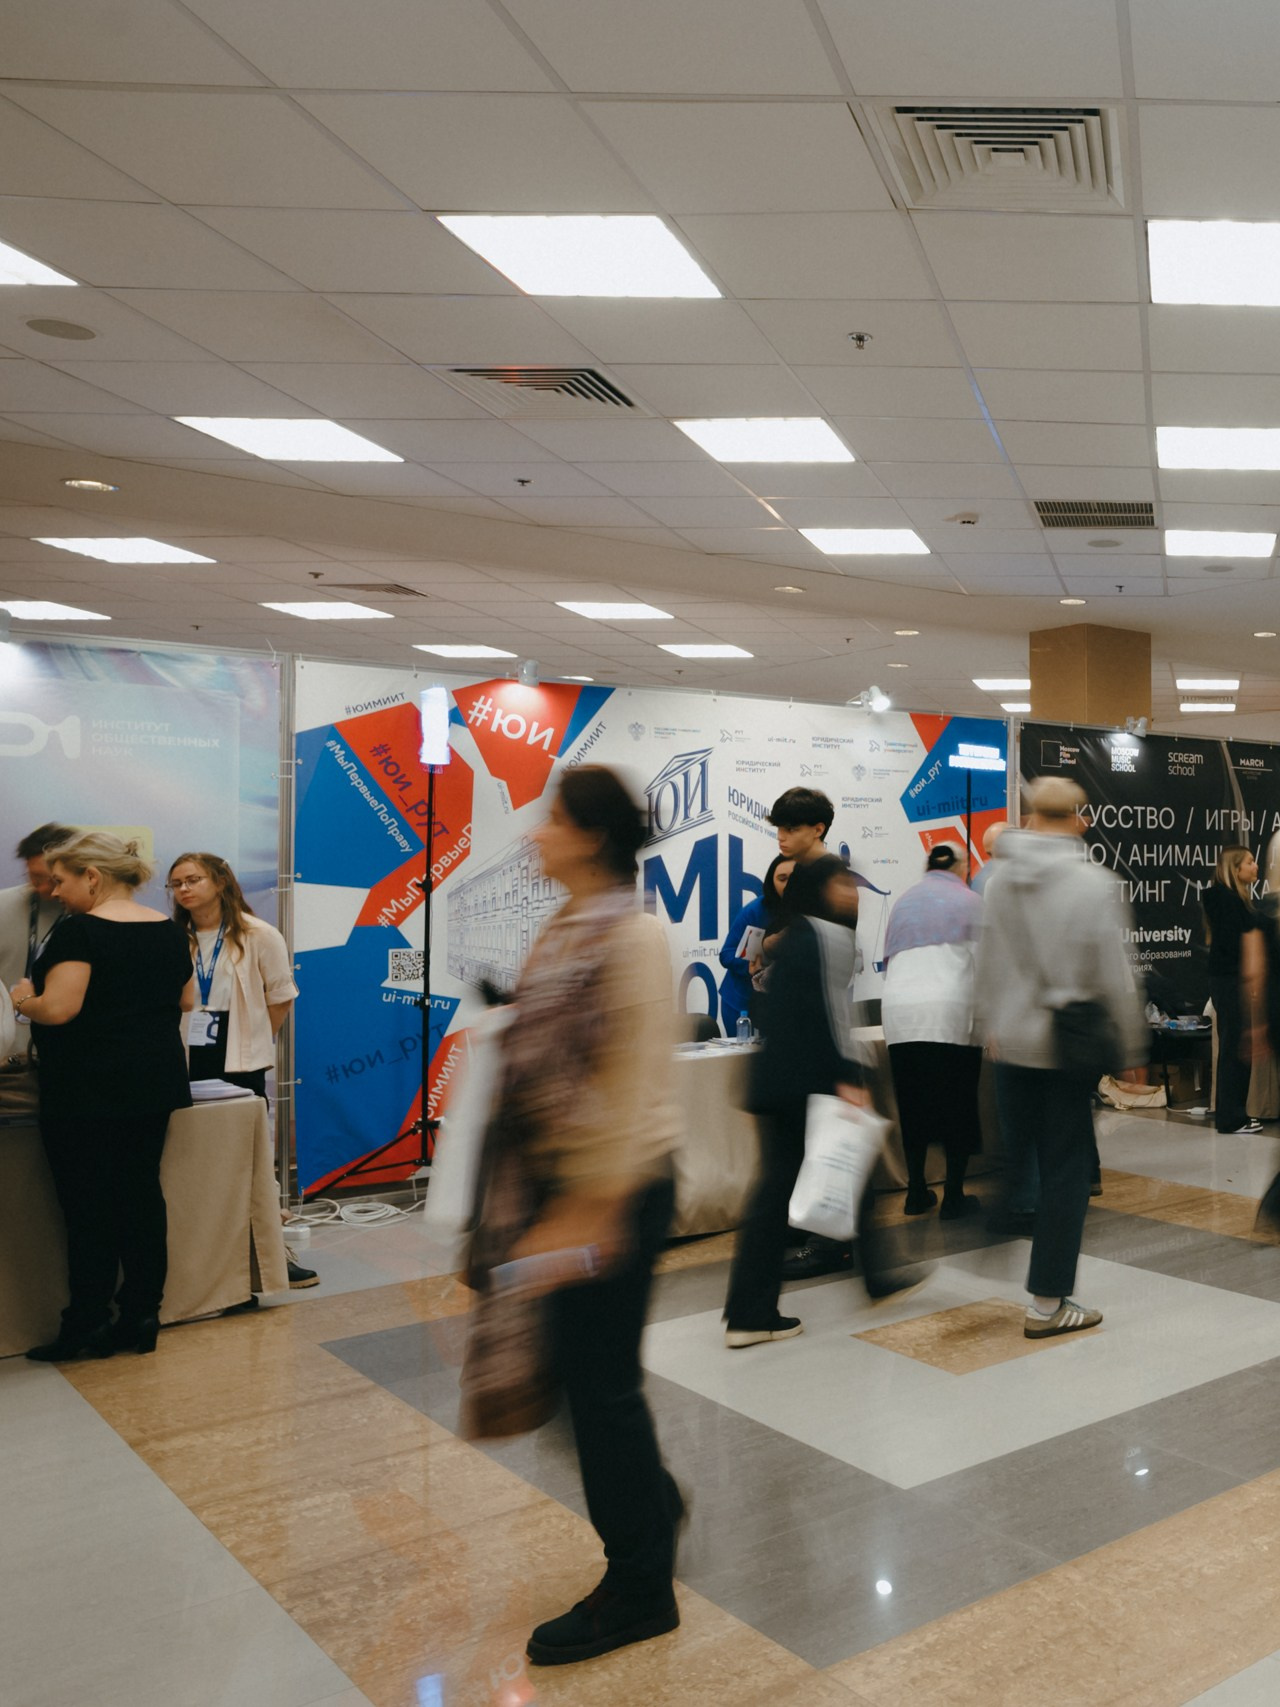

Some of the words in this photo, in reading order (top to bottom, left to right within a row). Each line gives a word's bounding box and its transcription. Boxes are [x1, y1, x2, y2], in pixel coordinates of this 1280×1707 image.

[92, 719, 171, 733] ИНСТИТУТ
[91, 732, 220, 748] ОБЩЕСТВЕННЫХ
[811, 736, 854, 744] ЮРИДИЧЕСКИЙ
[92, 746, 133, 757] НАУК
[736, 760, 781, 768] ЮРИДИЧЕСКИЙ
[1111, 756, 1132, 764] MUSIC
[1239, 758, 1264, 768] MARCH
[1111, 763, 1137, 773] SCHOOL
[1168, 765, 1196, 777] school
[908, 759, 943, 799] #юи_рут
[325, 739, 414, 854] #МыПервыеПоПраву
[1206, 809, 1254, 832] ИГРЫ
[1120, 925, 1192, 944] University
[1140, 949, 1192, 961] образования
